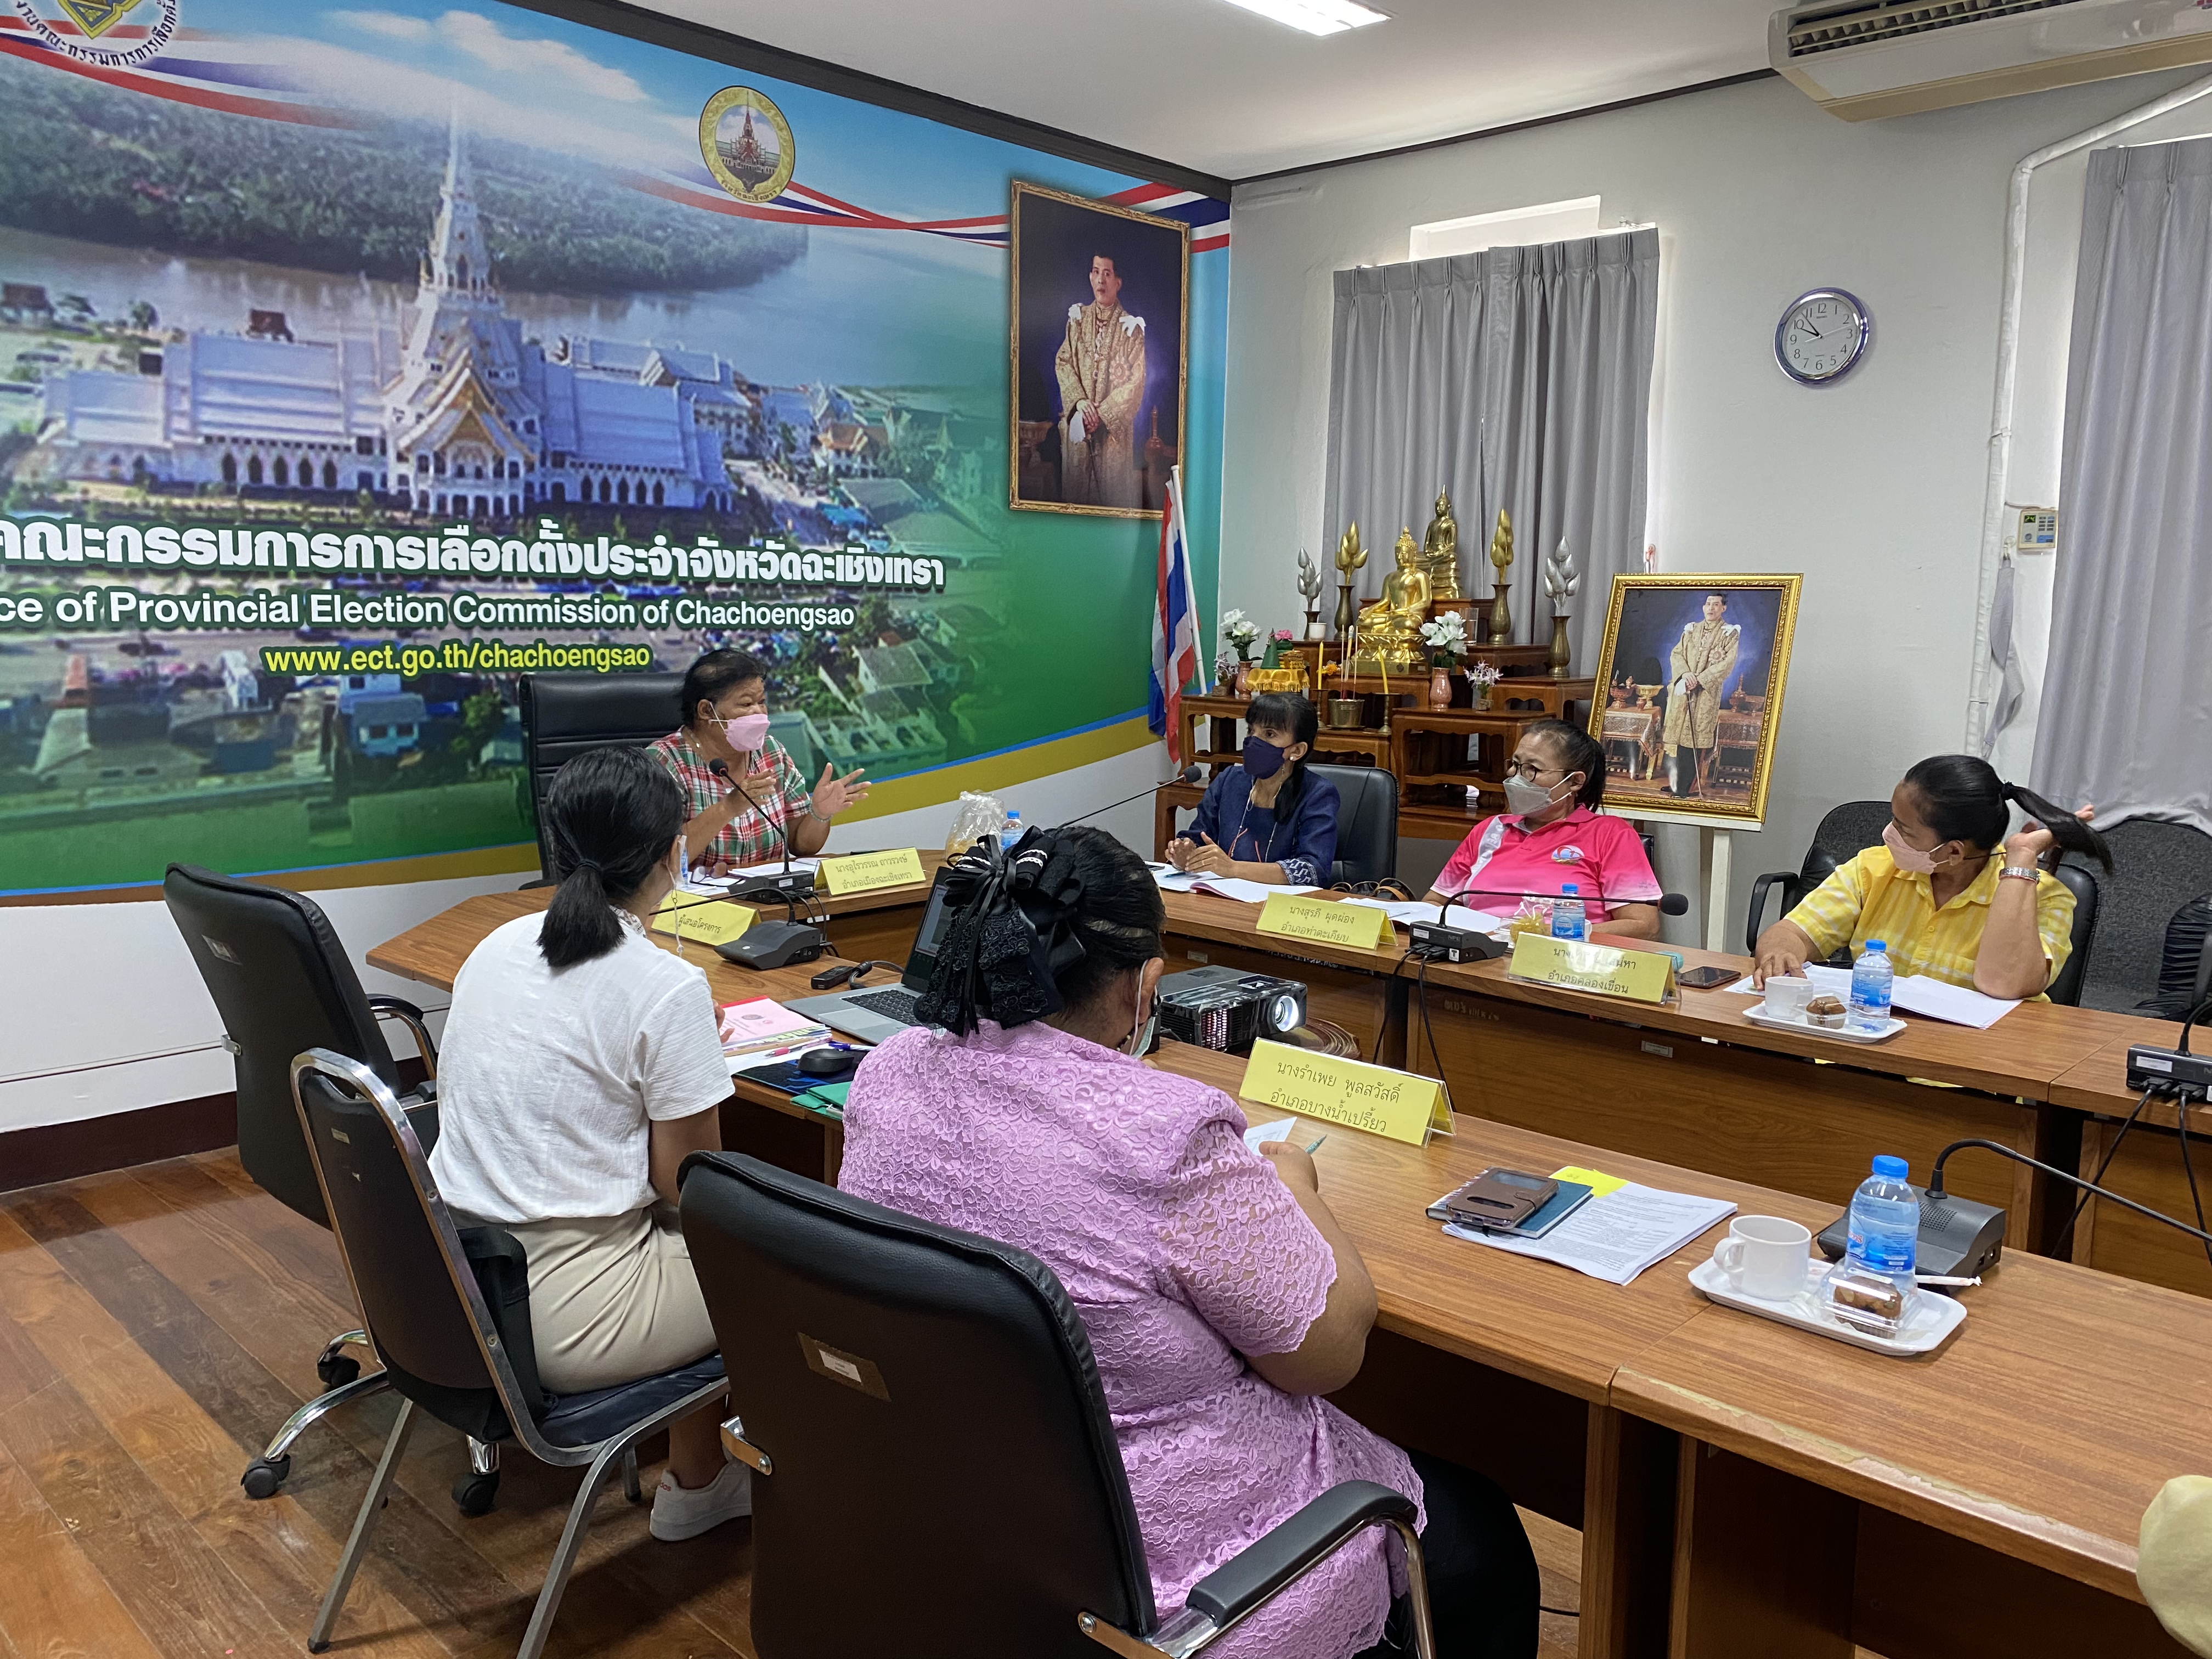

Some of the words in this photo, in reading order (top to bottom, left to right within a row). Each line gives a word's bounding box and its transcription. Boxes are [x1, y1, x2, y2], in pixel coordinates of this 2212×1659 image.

[1805, 307, 1813, 318] 11
[1818, 302, 1827, 313] 12
[1793, 319, 1804, 330] 10
[1843, 314, 1849, 324] 2
[1790, 334, 1797, 345] 9
[1846, 329, 1853, 339] 3
[1793, 348, 1801, 359] 8
[1840, 344, 1847, 354] 4
[1803, 358, 1809, 368] 7
[1815, 359, 1823, 370] 6
[1830, 355, 1837, 366] 5
[56, 591, 97, 623] of
[111, 591, 298, 623] Provincial
[311, 594, 443, 623] Election
[453, 596, 635, 624] Commission
[647, 599, 669, 624] of
[675, 600, 854, 631] Chachoengsao
[266, 644, 650, 676] www.ect.go.th/chachoengsao
[1280, 922, 1349, 943] อำเภอท่าตะเกียบ
[1548, 970, 1629, 994] อำเภอคลองเขื่อน
[1277, 1062, 1337, 1087] นางรำเพย
[1345, 1079, 1404, 1103] พูลสวัสดิ์
[1270, 1088, 1387, 1132] อำเภอบางน้ำเปรี้ยว
